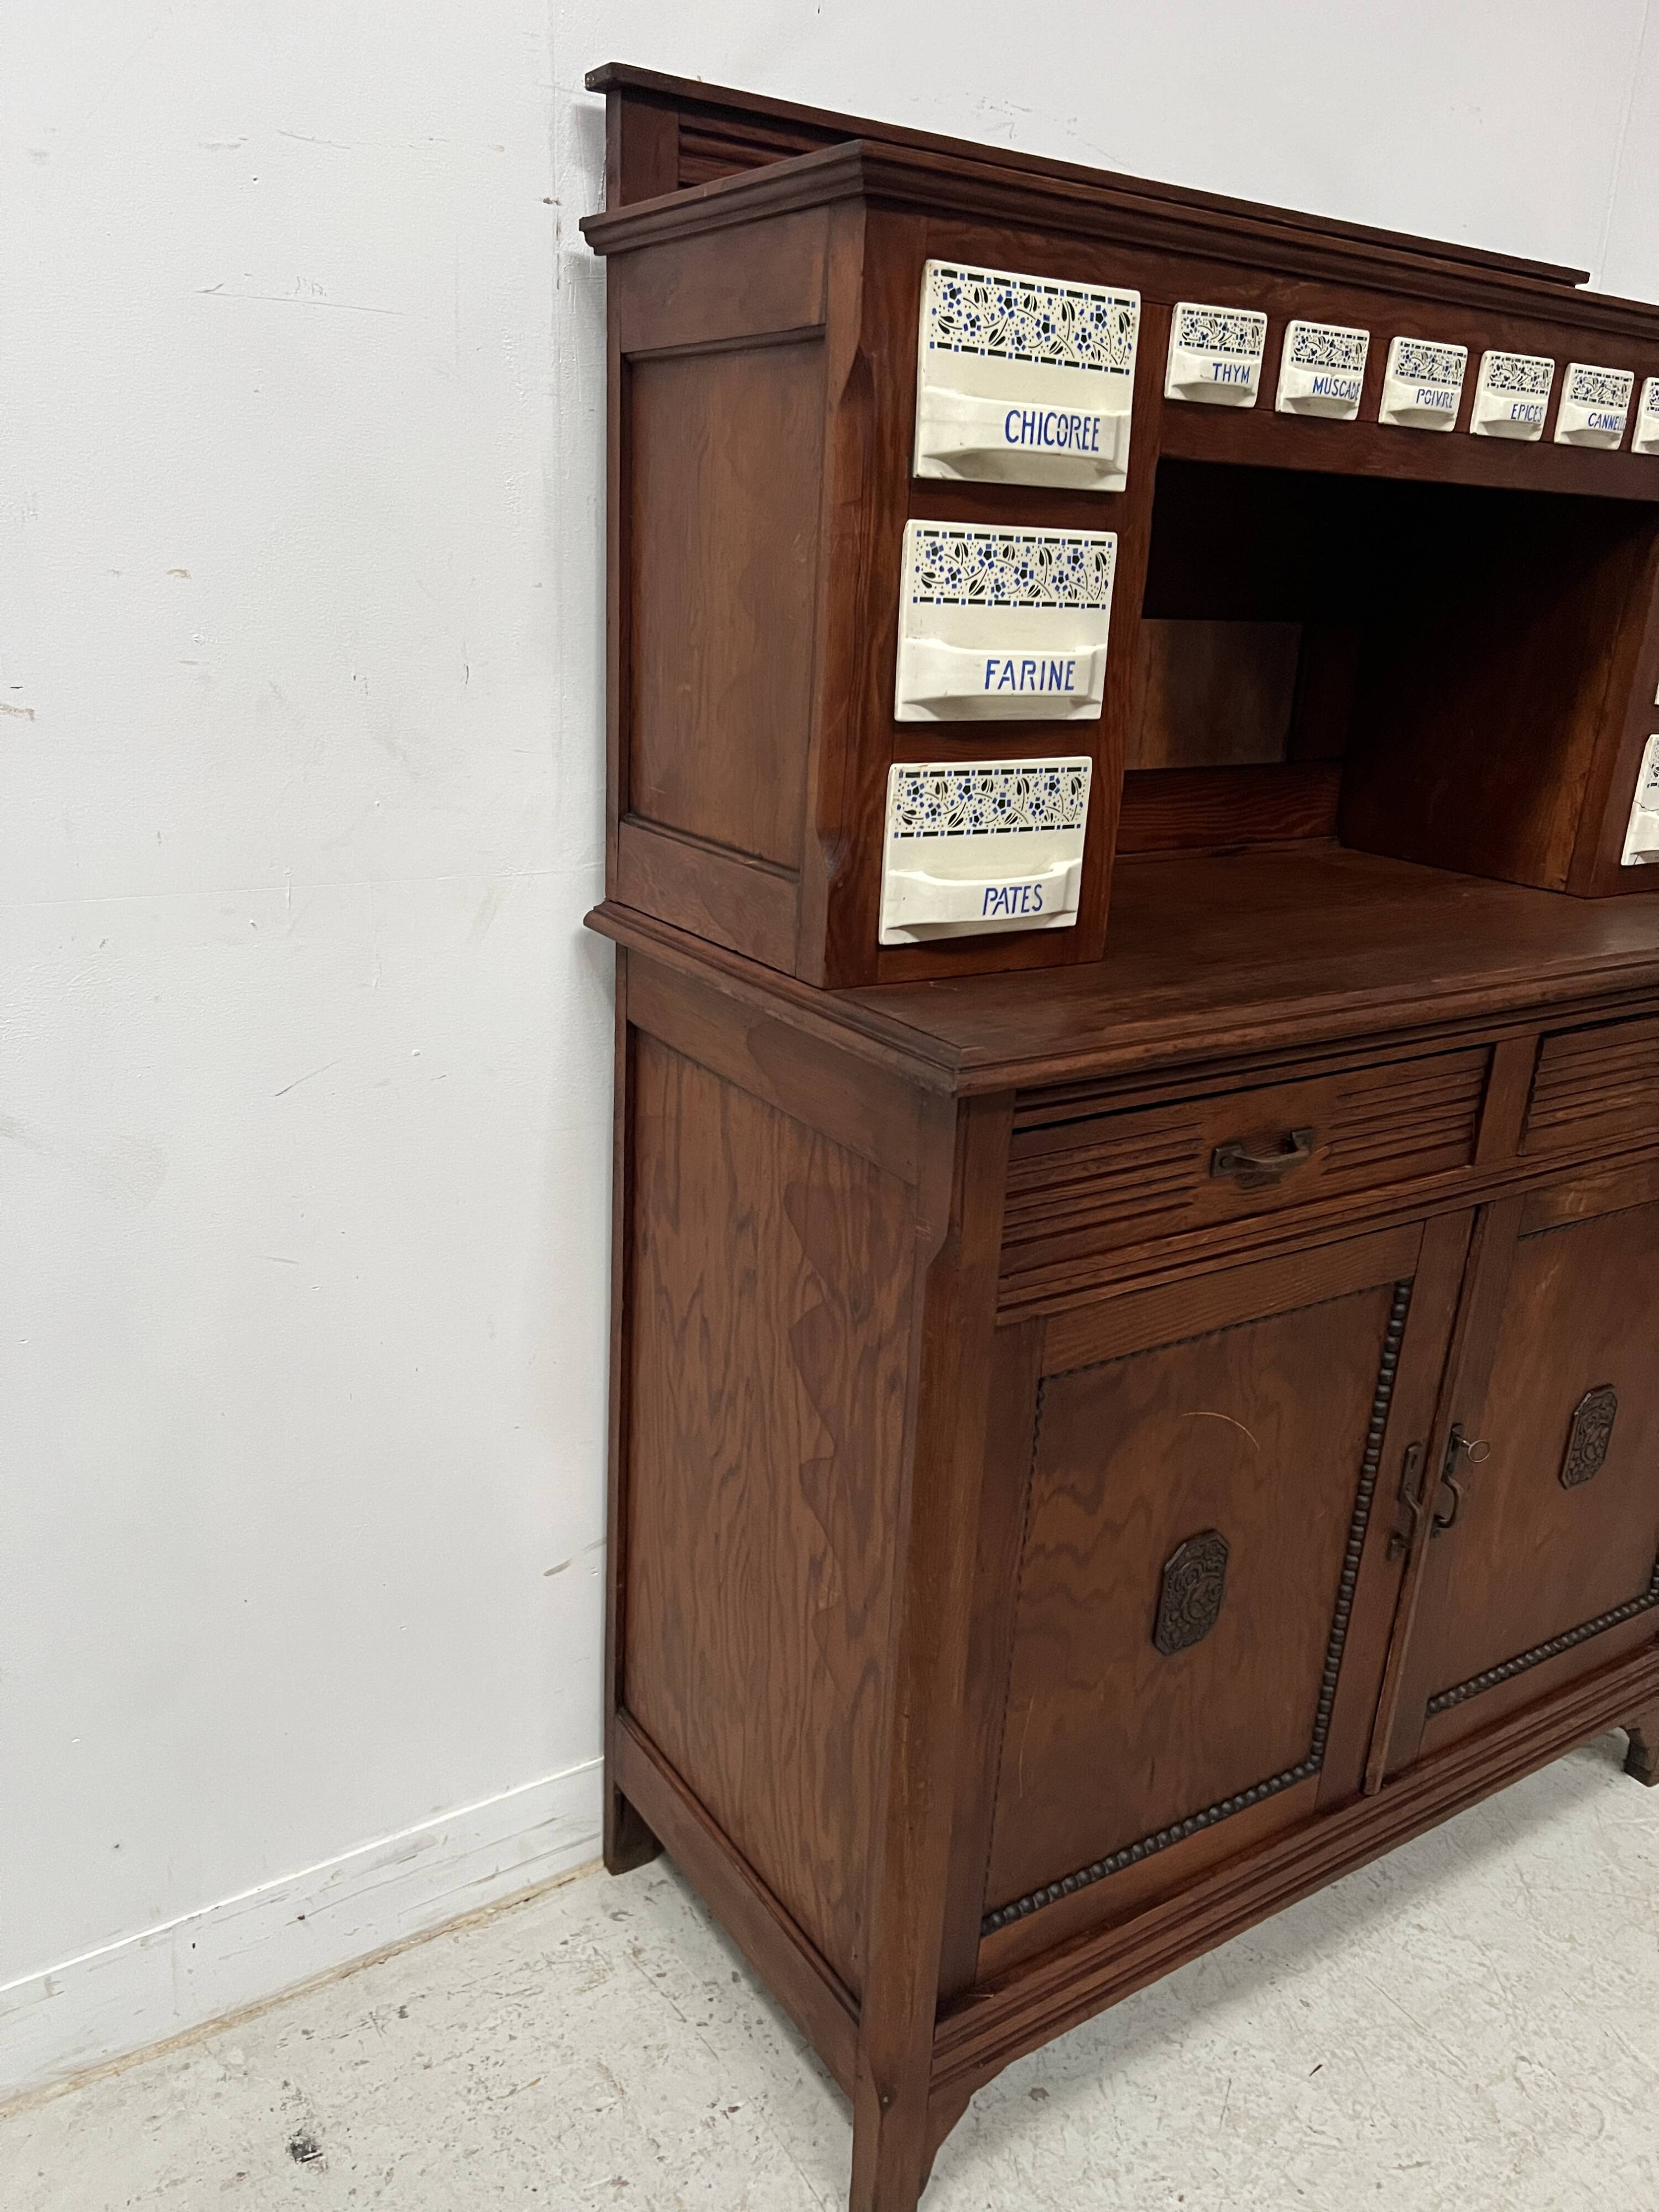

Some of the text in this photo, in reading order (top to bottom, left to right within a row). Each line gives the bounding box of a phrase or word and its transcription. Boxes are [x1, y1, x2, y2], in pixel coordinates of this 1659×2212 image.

[1213, 363, 1250, 384] THYM
[1416, 389, 1454, 408] POIVRE
[1510, 404, 1543, 422] EPICES
[1005, 409, 1100, 452] CHICOREE
[984, 659, 1076, 691] FARINE
[983, 884, 1042, 916] PATES
